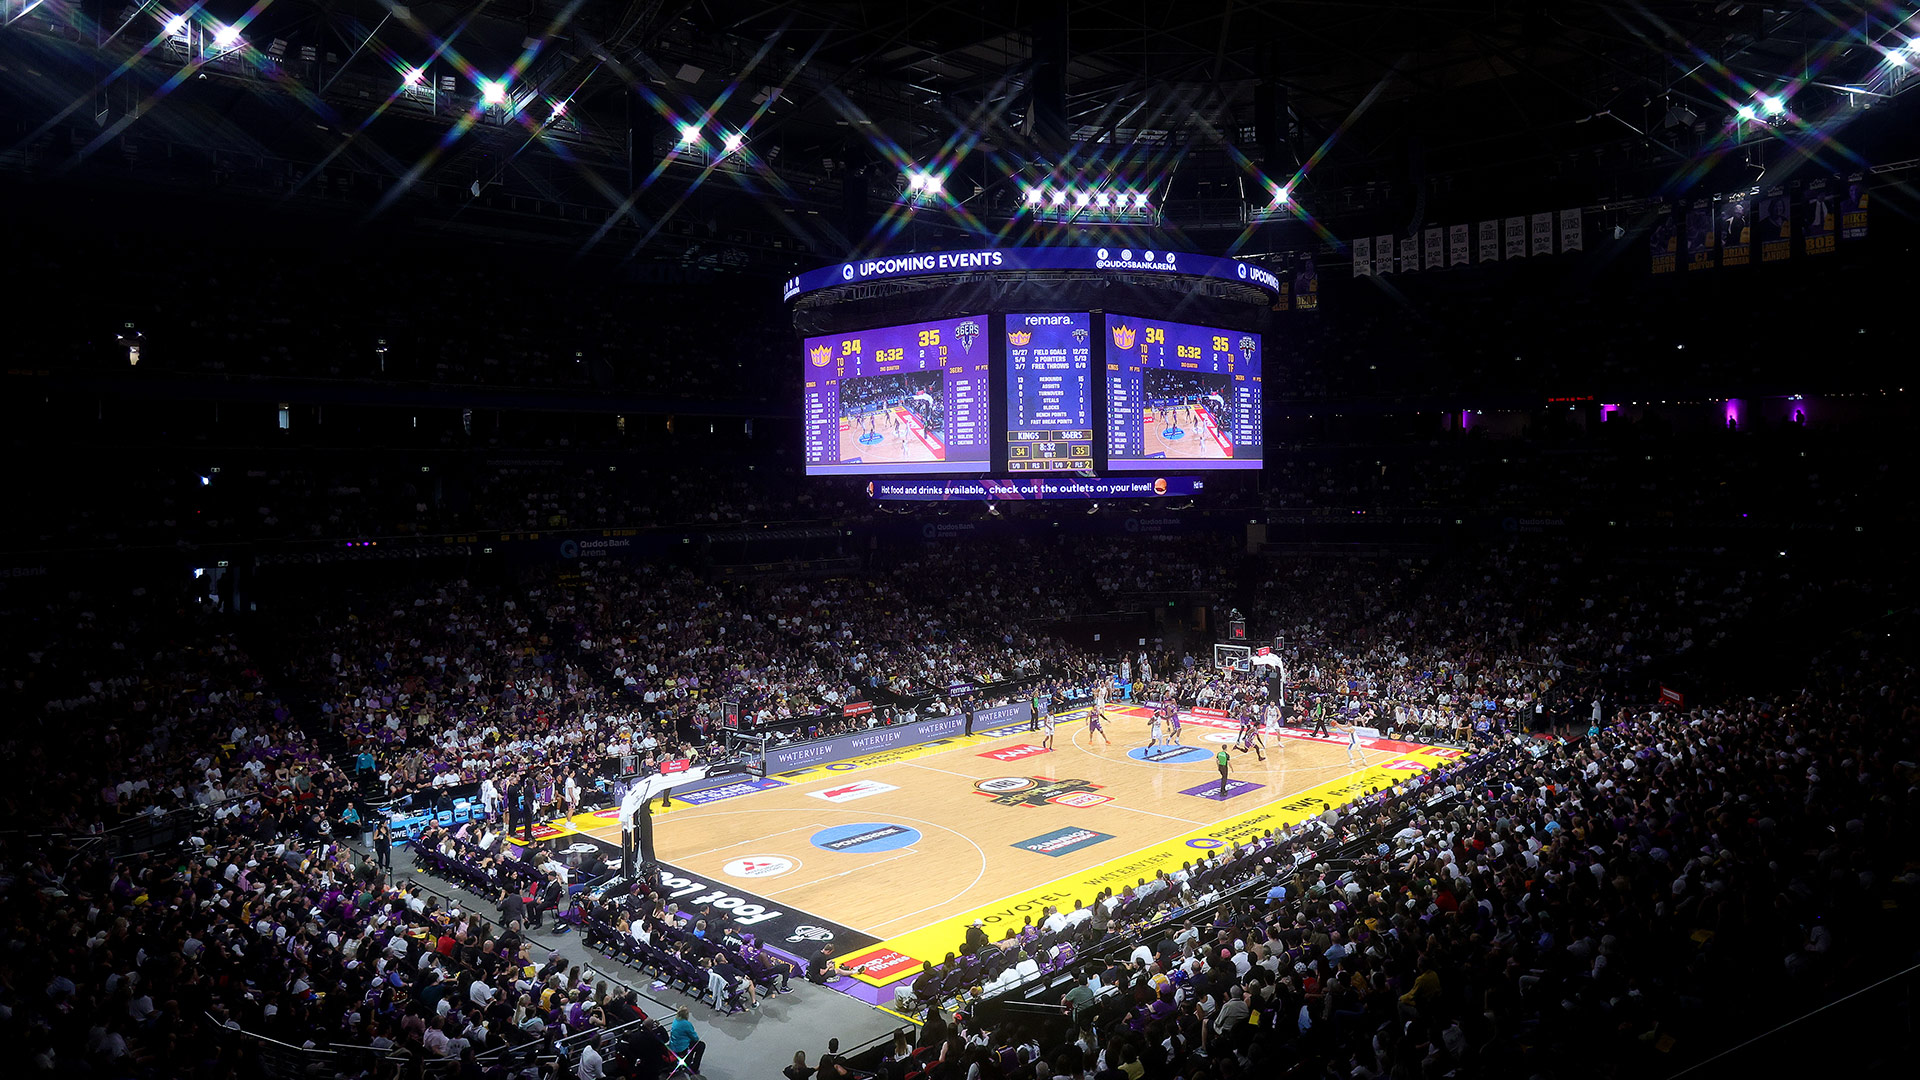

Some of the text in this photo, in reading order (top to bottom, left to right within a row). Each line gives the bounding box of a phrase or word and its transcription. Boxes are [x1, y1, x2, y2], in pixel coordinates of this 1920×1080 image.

[1805, 235, 1835, 250] BOB
[860, 256, 935, 276] UPCOMING
[939, 251, 1002, 268] EVENTS
[1096, 260, 1176, 271] @QUDOSBANKARENA
[1025, 316, 1074, 325] remara.
[955, 324, 979, 338] 36ERS
[1146, 327, 1164, 344] 34
[918, 330, 940, 347] 35
[1212, 336, 1229, 352] 35
[842, 339, 861, 355] 34
[919, 346, 947, 358] 2 TO
[1141, 344, 1148, 354] TO
[1177, 345, 1201, 359] 8:32
[837, 356, 861, 367] TO 1
[876, 348, 904, 362] 8:32
[1141, 355, 1164, 367] TF 1
[1228, 354, 1234, 362] TO
[920, 357, 947, 368] 2 TF
[1228, 364, 1234, 372] TF
[837, 368, 861, 377] TF 1
[1018, 432, 1039, 440] KINGS
[1016, 448, 1025, 456] 34
[1040, 443, 1055, 451] 8:32
[1076, 447, 1085, 455] 35
[1067, 461, 1071, 469] 2
[882, 486, 890, 494] Hot
[890, 485, 904, 494] food
[905, 485, 917, 494] and
[918, 485, 942, 494] drinks
[944, 485, 987, 495] available,
[989, 485, 1018, 494] check
[1021, 485, 1038, 493] out
[1041, 484, 1057, 493] the
[1060, 484, 1094, 493] outlets
[1110, 485, 1129, 494] your
[1132, 483, 1151, 492] level!
[978, 708, 1020, 722] WATERVIEW
[918, 719, 963, 735] WATERVIEW
[852, 731, 901, 748] WATERVIEW
[778, 745, 833, 763] WATERVIEW
[1281, 797, 1324, 812] RWS
[1208, 814, 1276, 838] Qudos Bank
[1224, 827, 1263, 842] Arena
[1083, 852, 1173, 886] WATERVIEW
[966, 892, 1072, 928] OVOTEL
[869, 956, 910, 972] fitness
